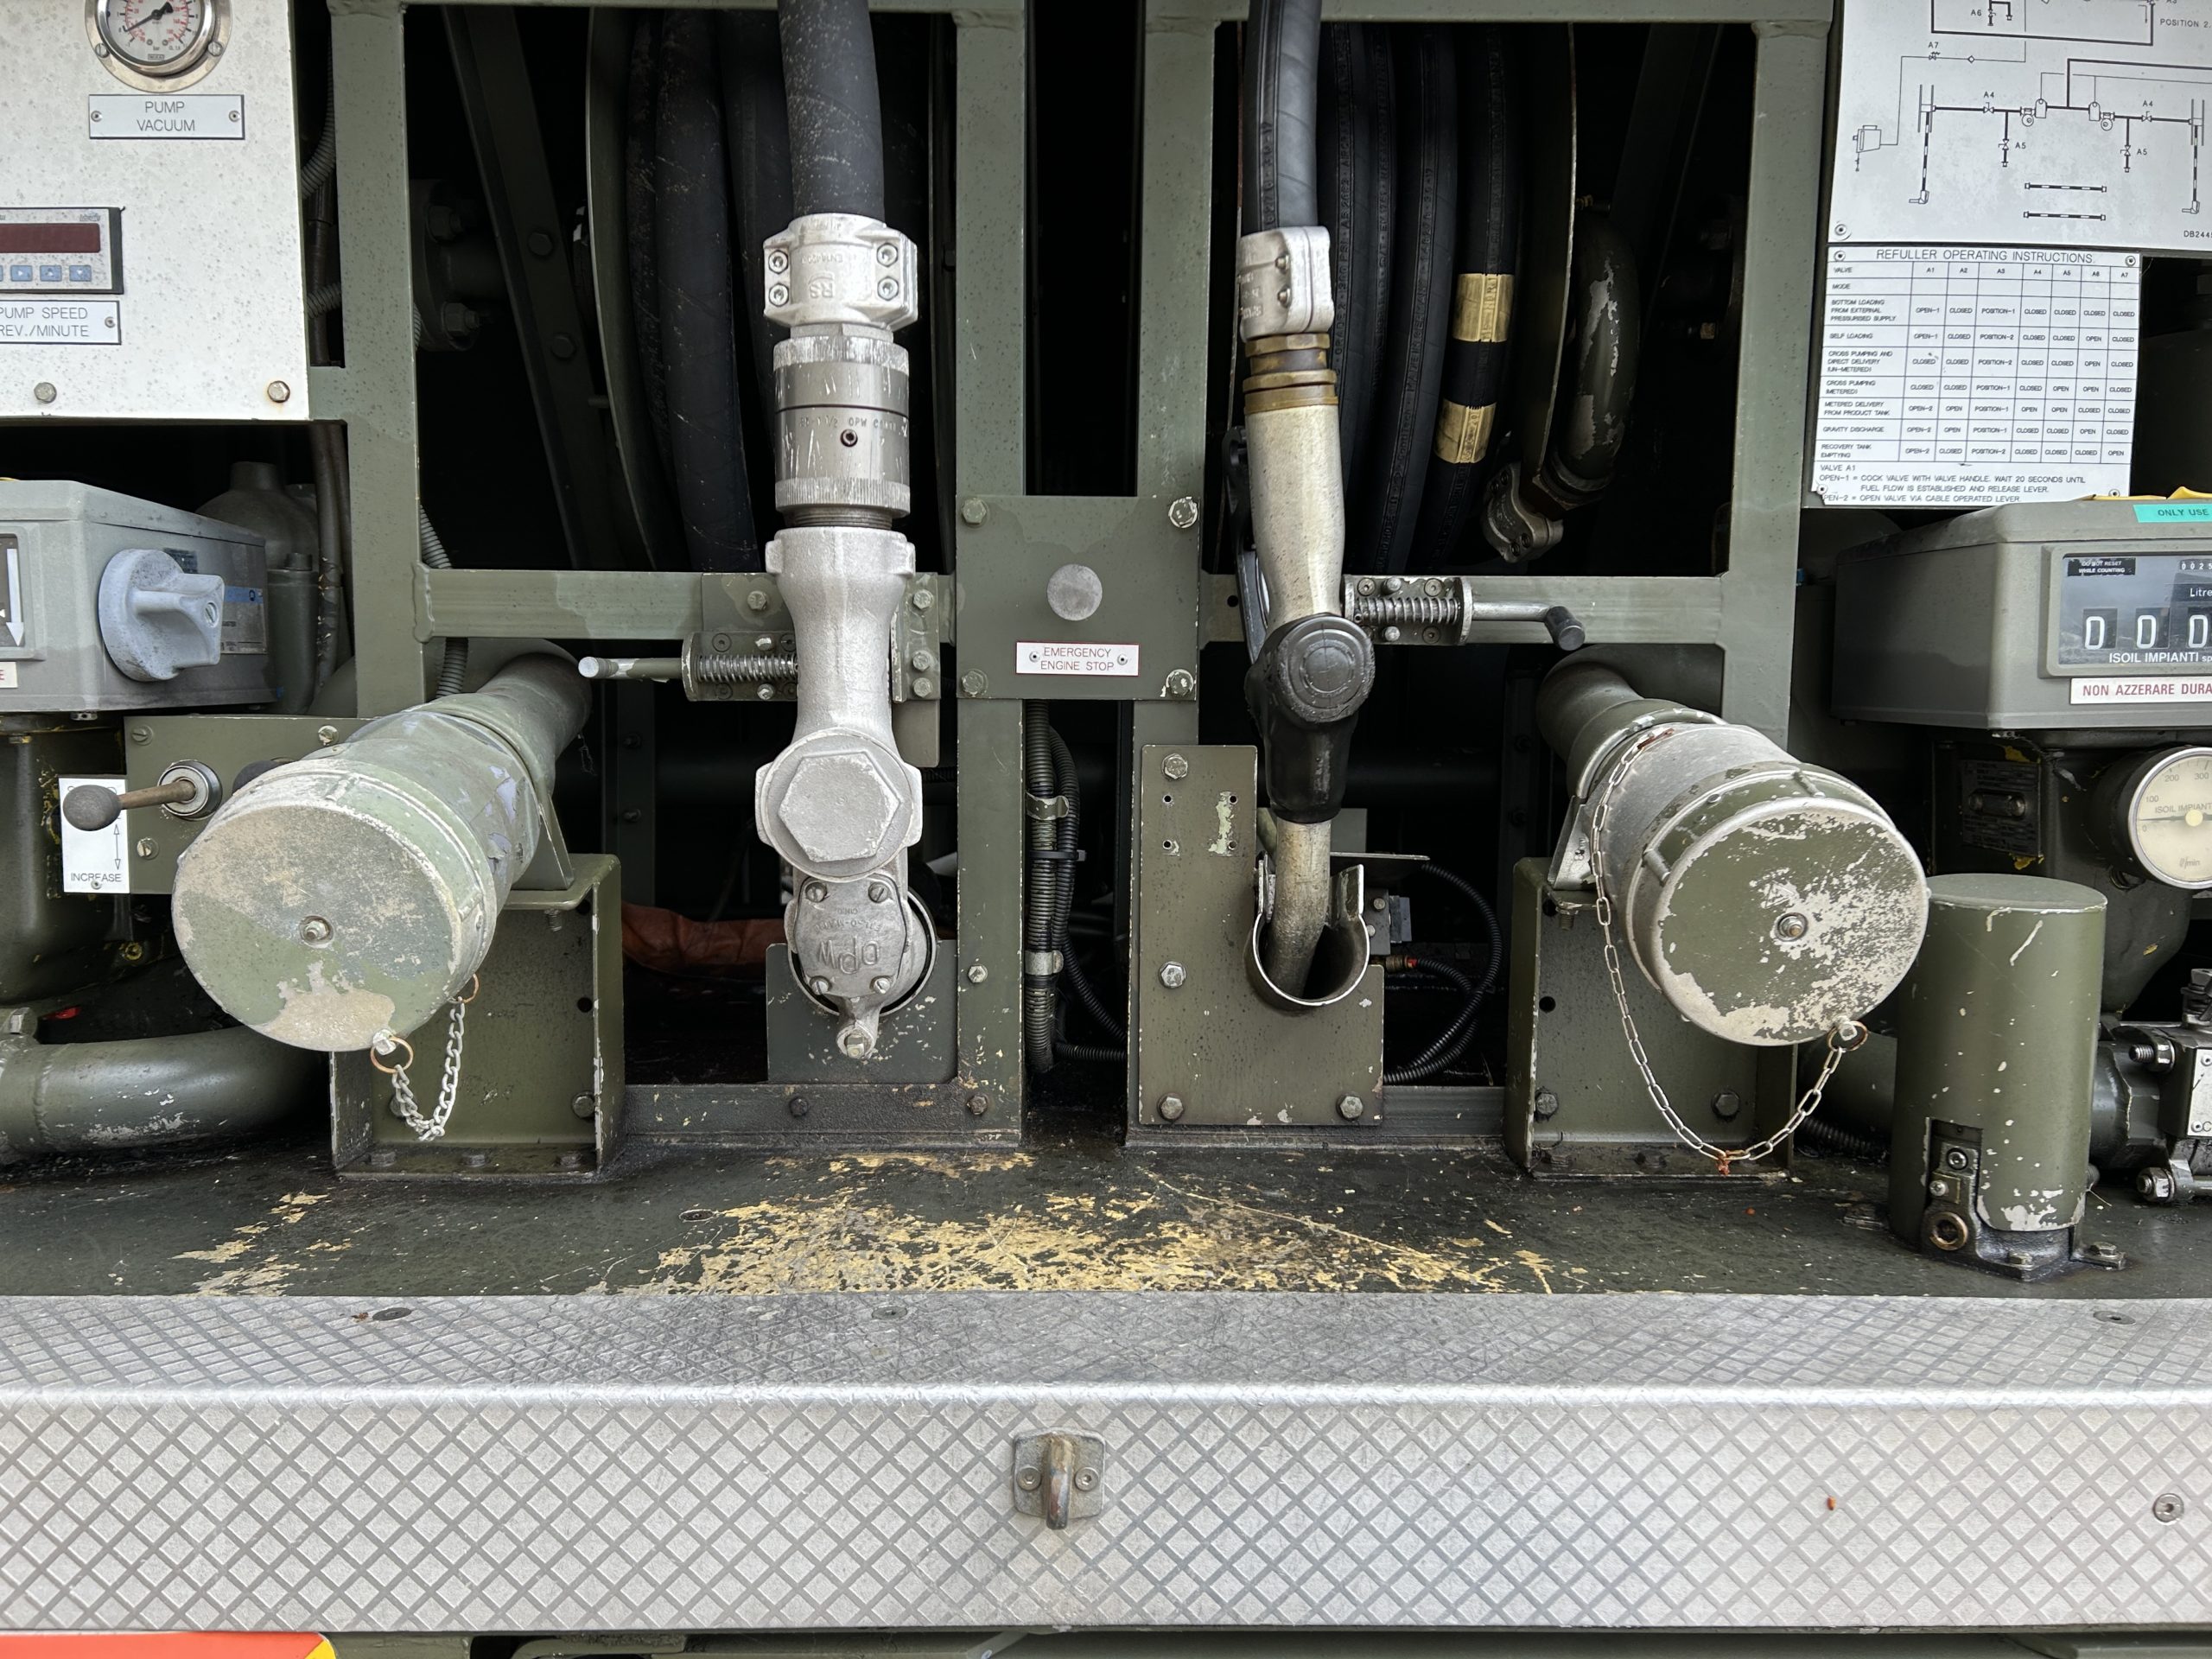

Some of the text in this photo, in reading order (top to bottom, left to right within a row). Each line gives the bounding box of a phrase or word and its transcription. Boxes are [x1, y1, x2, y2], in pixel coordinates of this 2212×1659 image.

[2160, 18, 2199, 28] POSITION
[145, 101, 185, 113] PUMP
[137, 119, 195, 131] VACUUM
[2183, 230, 2212, 238] DB244
[1877, 250, 1937, 259] REFULLER
[1943, 250, 2007, 261] OPERATING
[0, 307, 88, 320] PUMP SPEED
[1408, 355, 1421, 391] MADE
[849, 417, 868, 428] OPW
[1044, 647, 1111, 658] EMERGENCY
[2109, 652, 2141, 664] ISOIL
[2145, 652, 2199, 663] IMPIANTI
[1040, 661, 1115, 671] ENGINE STOP
[2082, 685, 2109, 696] NON
[2115, 684, 2175, 696] AZZERARE
[2155, 805, 2177, 814] ISOIL
[71, 873, 122, 882] INCREASE
[818, 936, 881, 976] OPW
